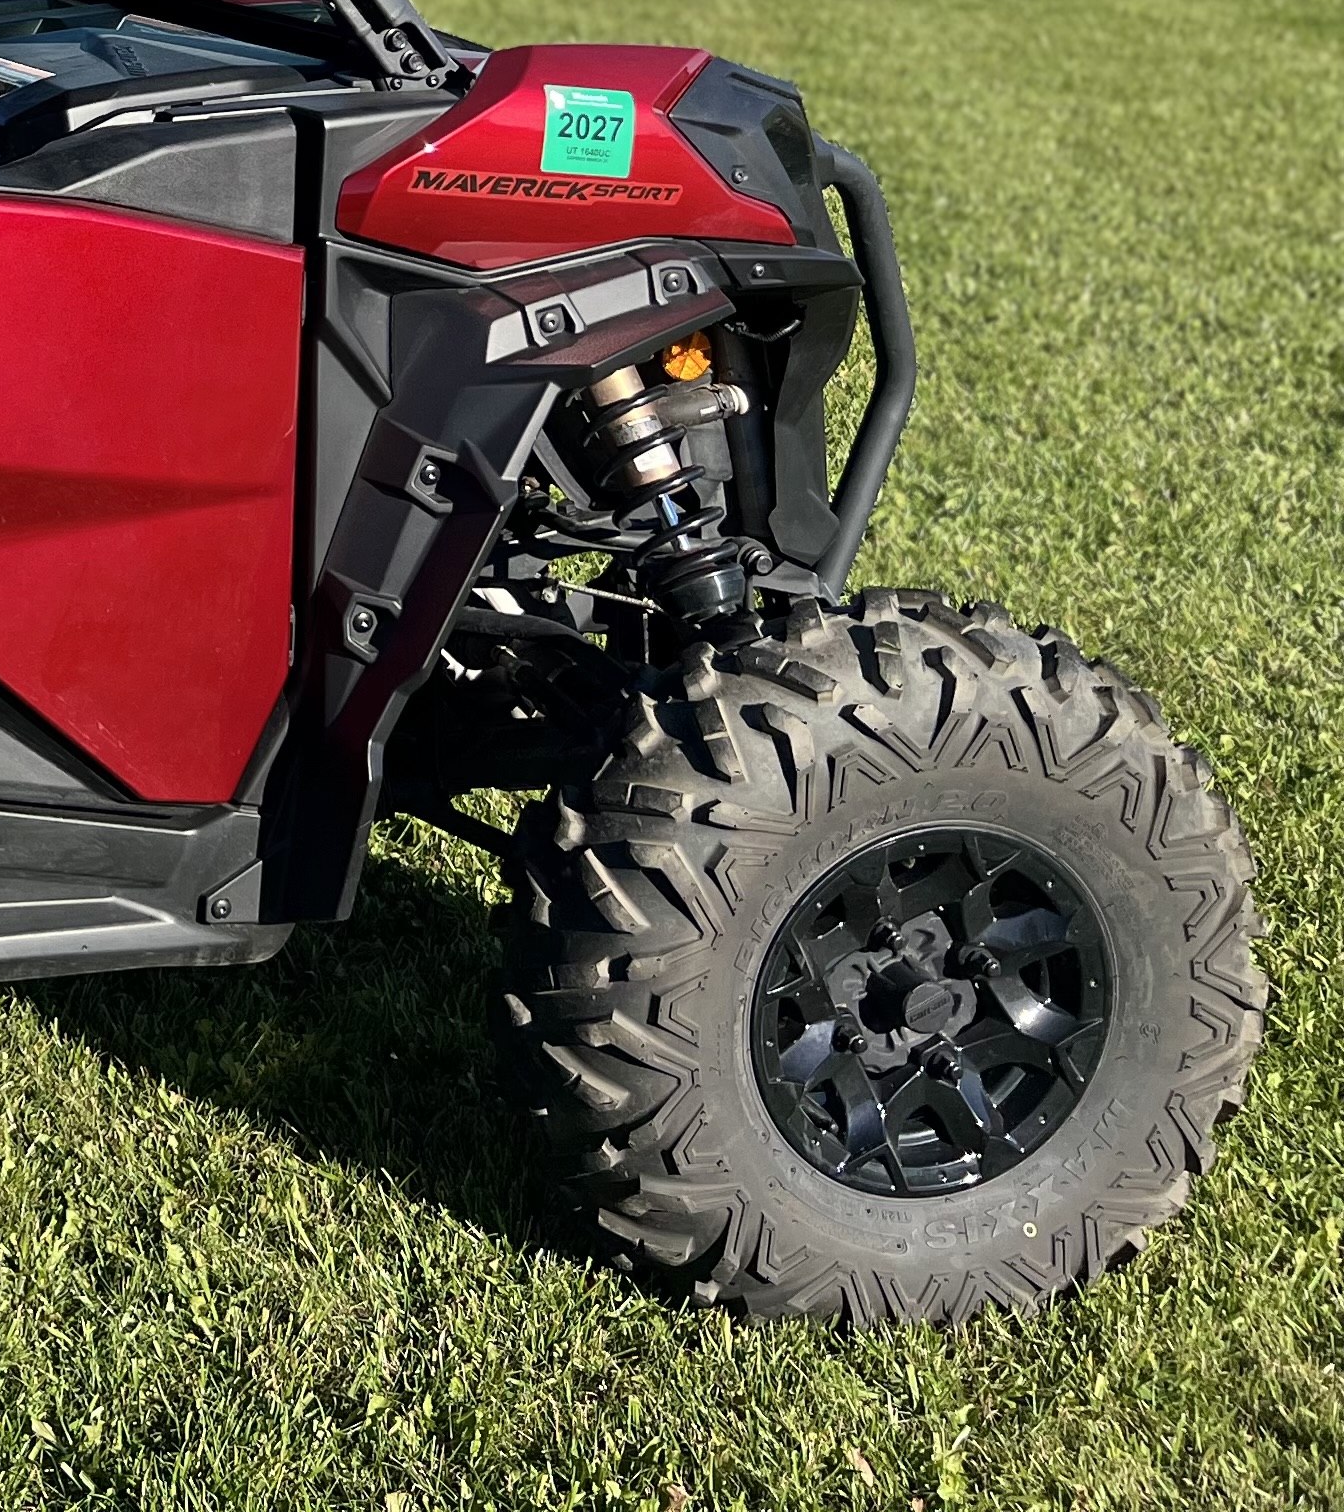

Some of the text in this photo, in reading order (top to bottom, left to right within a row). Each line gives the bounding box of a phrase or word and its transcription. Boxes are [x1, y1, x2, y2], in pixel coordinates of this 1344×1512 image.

[557, 112, 624, 143] 2027
[412, 170, 679, 201] MAVERICK SPORT
[924, 1097, 1133, 1250] MAXXIS
